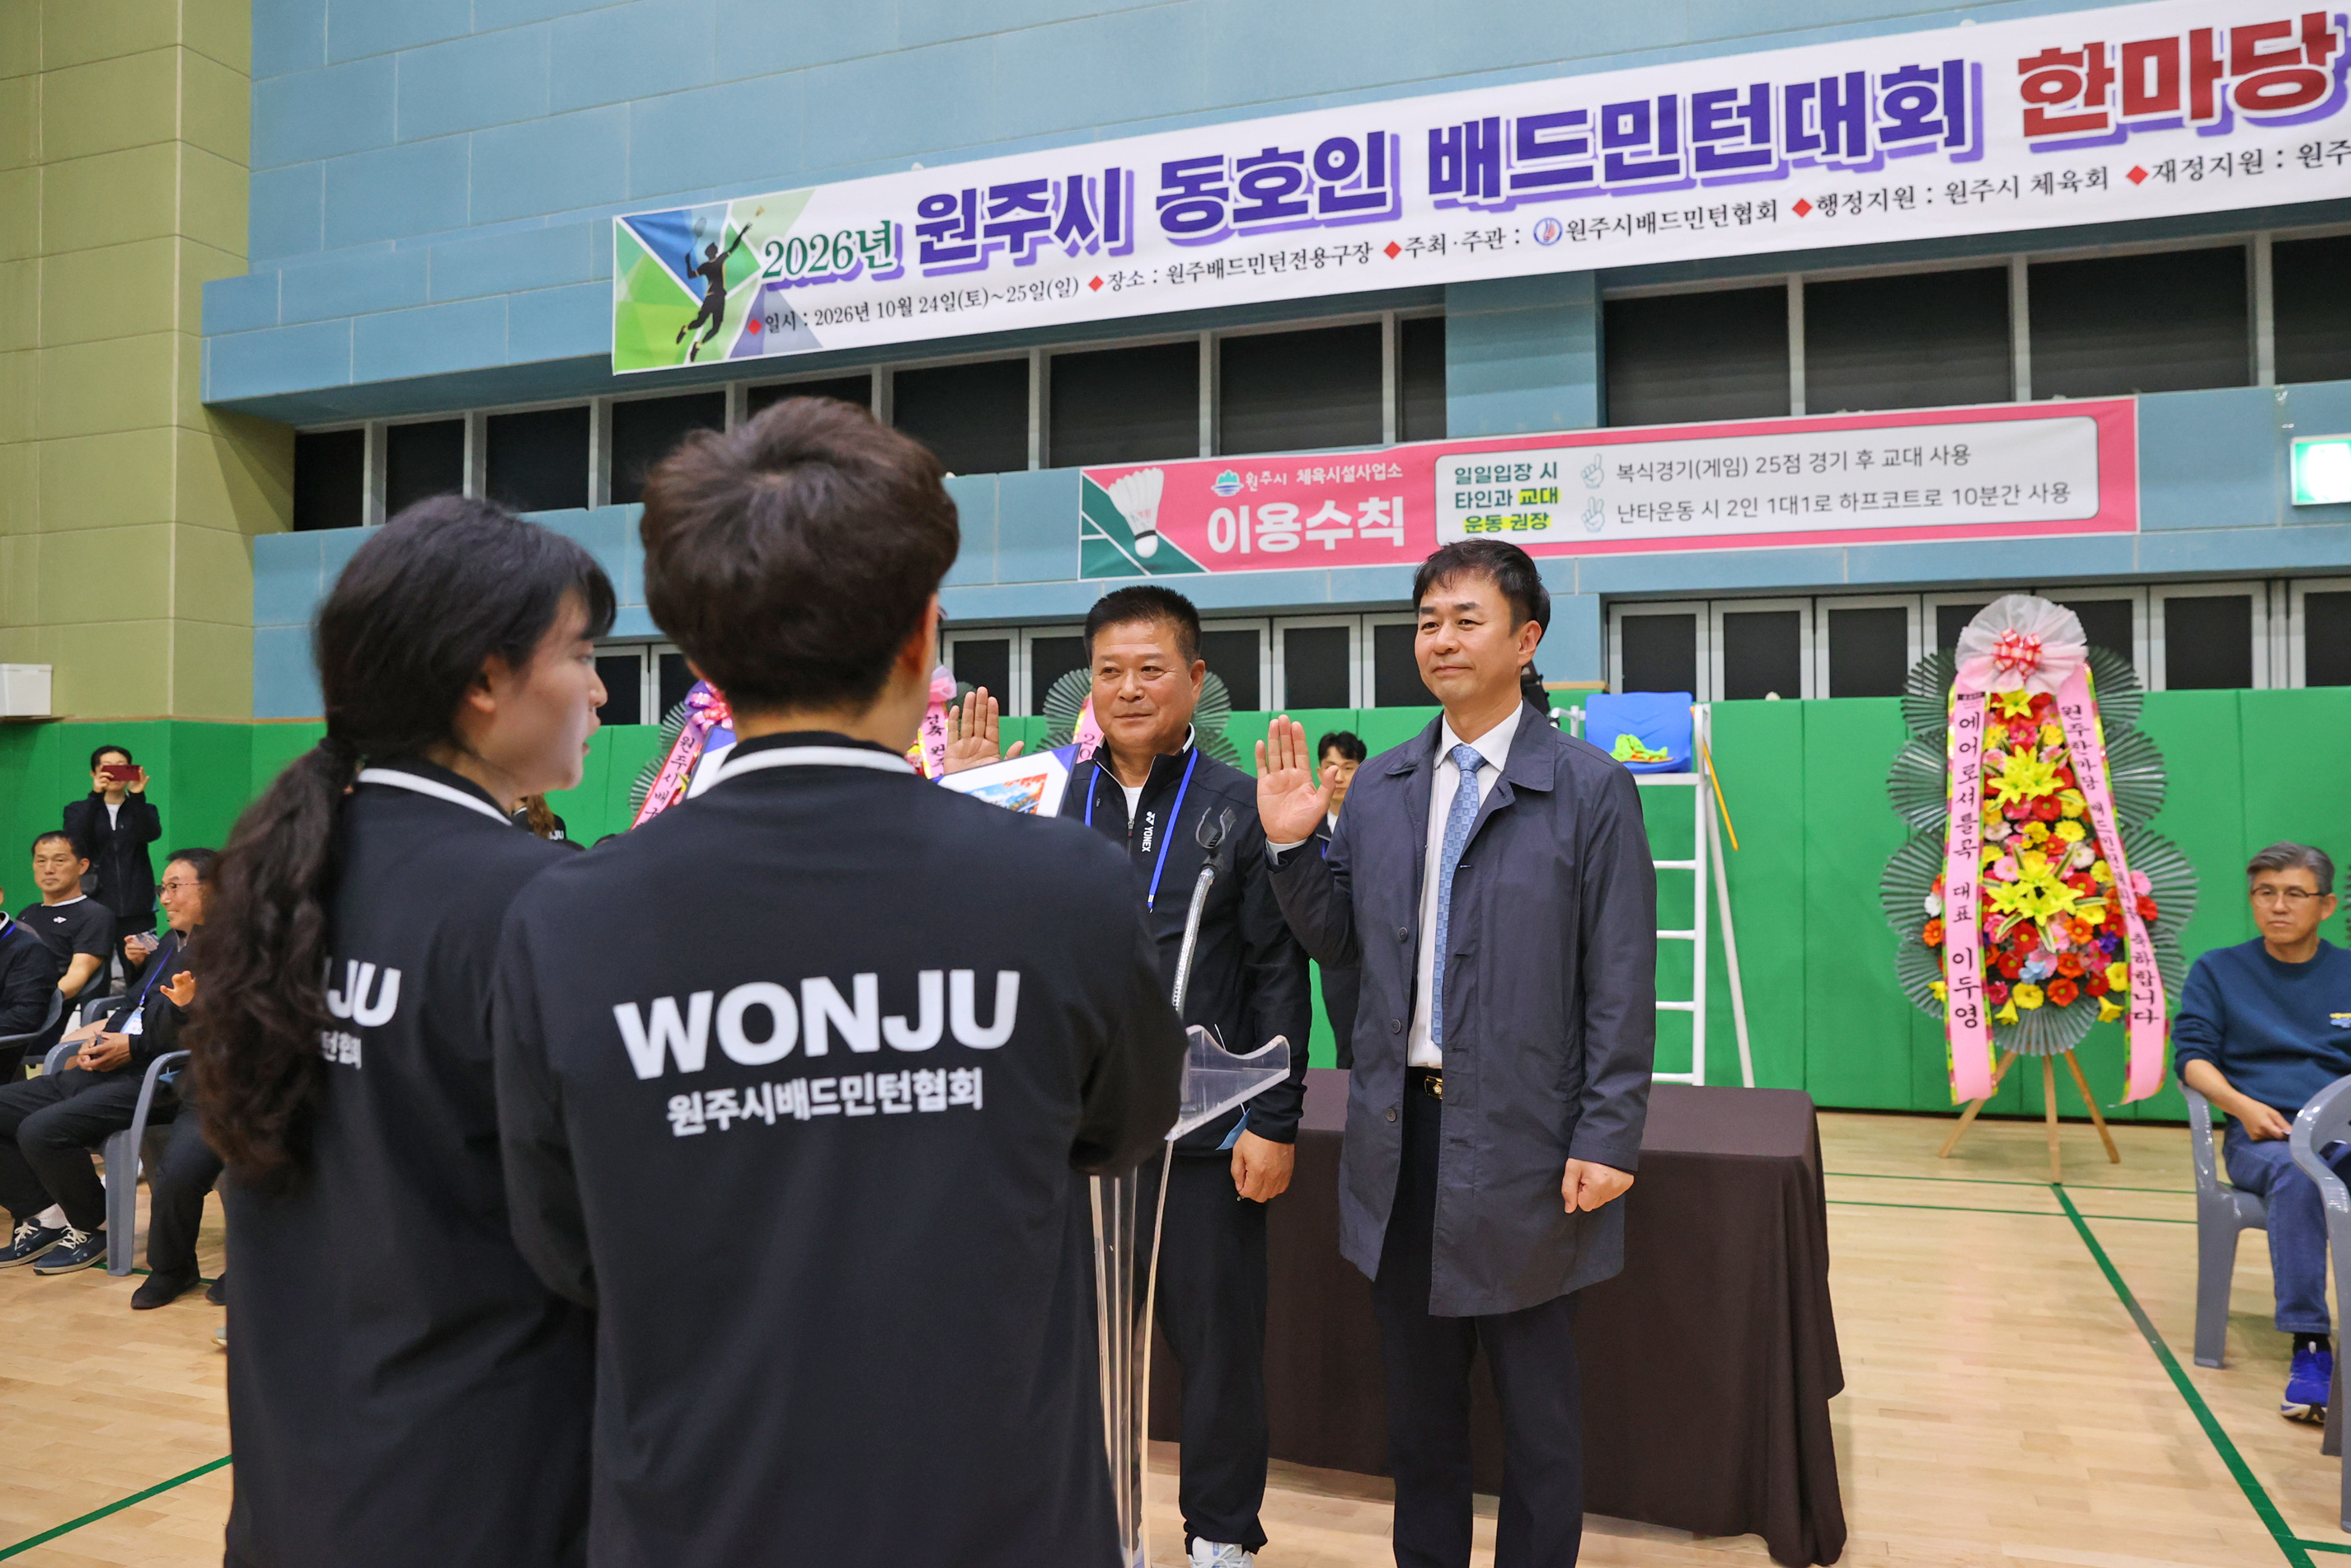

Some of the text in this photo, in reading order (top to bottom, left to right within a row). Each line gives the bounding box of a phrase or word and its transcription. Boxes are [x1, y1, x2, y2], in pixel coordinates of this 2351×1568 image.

[763, 12, 2336, 279] 2026년 원주시 동호인 배드민턴대회 한마당
[764, 310, 796, 333] 일시
[815, 302, 870, 326] 2026년
[877, 296, 913, 318] 10월
[1106, 271, 1145, 292] 장소
[1166, 242, 1373, 284] 원주배드민턴전용구장
[1565, 200, 1777, 242] 원주시배드민턴협회
[1816, 185, 1915, 217] 행정지원
[1945, 175, 2020, 205] 원주시
[2030, 167, 2108, 195] 체육회
[2152, 148, 2264, 183] 재정지원
[1245, 462, 1403, 492] 원주시 체육시설사업소
[1454, 462, 1558, 485] 일일입장 시
[1617, 444, 1971, 482] 복식경기(게임) 25점 경기 후 교대 사용
[1455, 486, 1559, 509] 타인과 교대
[1617, 481, 2070, 524] 난타운동 시 2인 1대1로 하프코트로 10분간 사용
[1207, 496, 1405, 554] 이용수칙
[1464, 511, 1551, 533] 운동 권장
[1141, 826, 1154, 852] YONEX
[612, 969, 1021, 1080] WONJU
[666, 1066, 984, 1137] 원주시배드민턴협회
